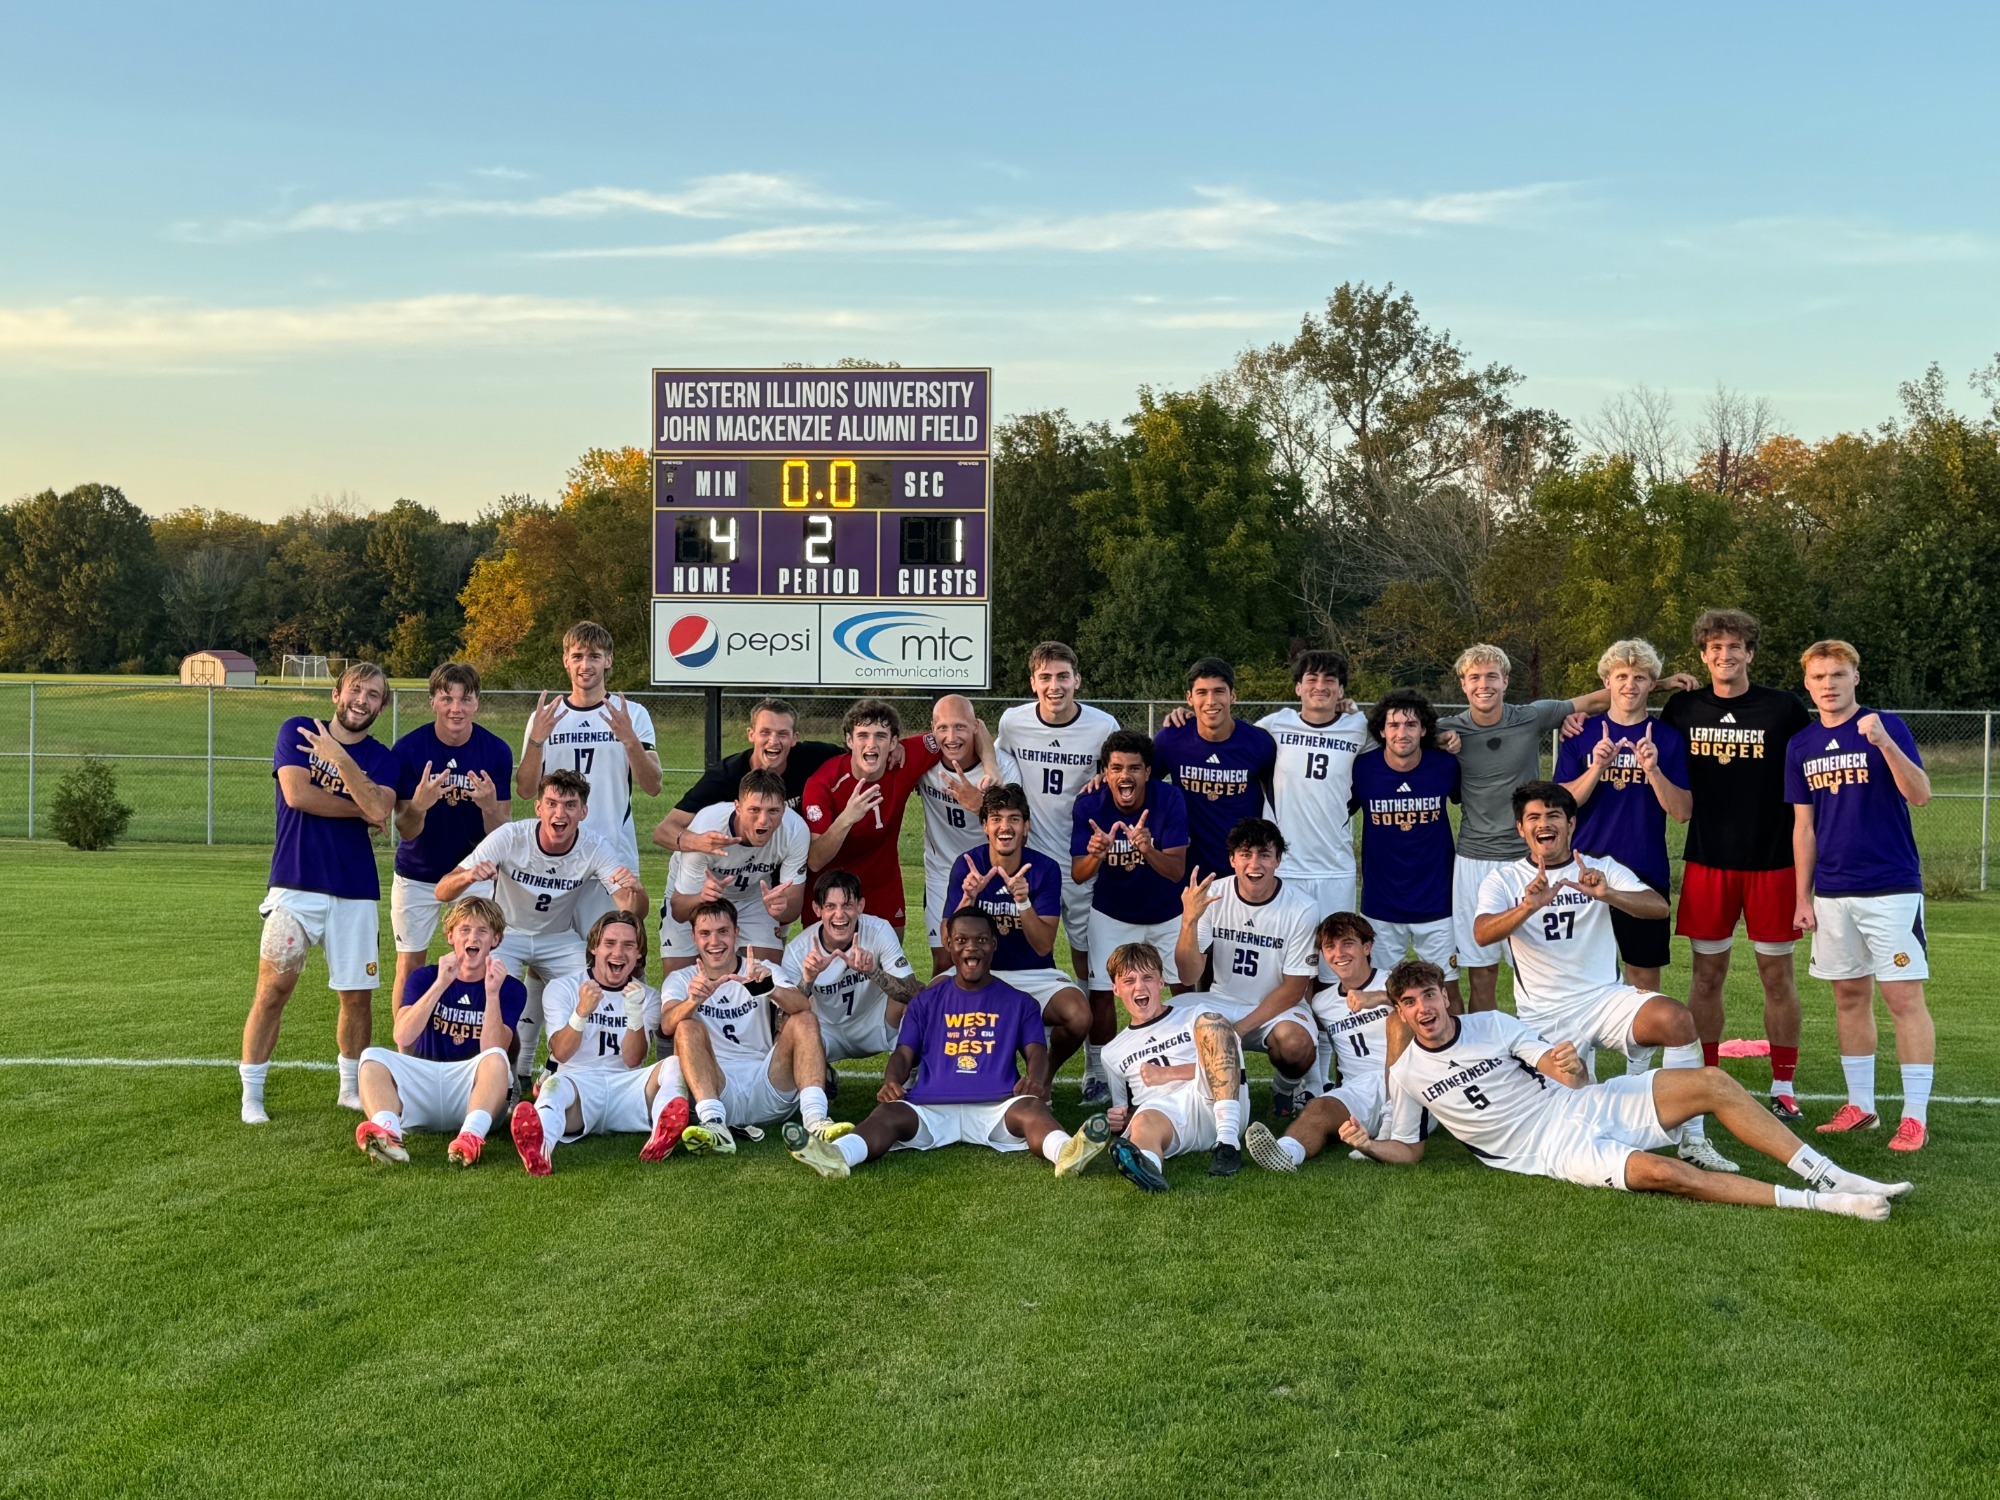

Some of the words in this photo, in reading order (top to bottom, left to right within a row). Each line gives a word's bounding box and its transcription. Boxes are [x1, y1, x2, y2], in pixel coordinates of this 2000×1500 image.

[665, 382, 760, 408] WESTERN
[766, 381, 849, 408] ILLINOIS
[854, 381, 974, 408] UNIVERSITY
[660, 416, 710, 442] JOHN
[716, 415, 833, 441] MACKENZIE
[837, 415, 916, 442] ALUMNI
[921, 415, 978, 442] FIELD
[695, 470, 737, 497] MIN
[782, 460, 856, 507] 0.0
[904, 471, 944, 497] SEC
[709, 516, 737, 561] 4
[805, 515, 833, 563] 2
[954, 518, 963, 562] 1
[673, 567, 731, 593] HOME
[779, 568, 860, 594] PERIOD
[898, 568, 977, 595] GUESTS
[727, 628, 810, 656] pepsi
[901, 627, 974, 661] mtc
[855, 665, 969, 678] communications
[1280, 734, 1358, 753] LEATHERNECKS
[1690, 727, 1765, 744] LEATHERNECK
[574, 748, 595, 774] 17
[1017, 748, 1093, 766] LEATHERNECKS
[1690, 742, 1765, 758] SOCCER
[1180, 765, 1249, 783] LEATHERNECK
[1305, 752, 1329, 780] 13
[1042, 767, 1064, 795] 19
[1180, 778, 1248, 796] SOCCER
[946, 805, 966, 828] 18
[1370, 796, 1441, 812] LEATHERNECK
[1371, 810, 1440, 825] SOCCER
[734, 875, 749, 892] 4
[535, 893, 552, 912] 2
[1212, 927, 1284, 949] LEATHERNECKS
[1543, 911, 1575, 940] 27
[1232, 948, 1259, 977] 25
[842, 990, 855, 1016] 7
[434, 1017, 482, 1039] SOCCE
[944, 1012, 999, 1028] WEST
[598, 1031, 620, 1056] 14
[722, 1024, 740, 1044] 6
[1349, 1032, 1370, 1057] 11
[944, 1040, 996, 1056] BEST
[1422, 1058, 1503, 1102] LEATHERNECKS
[1463, 1084, 1491, 1110] 5
